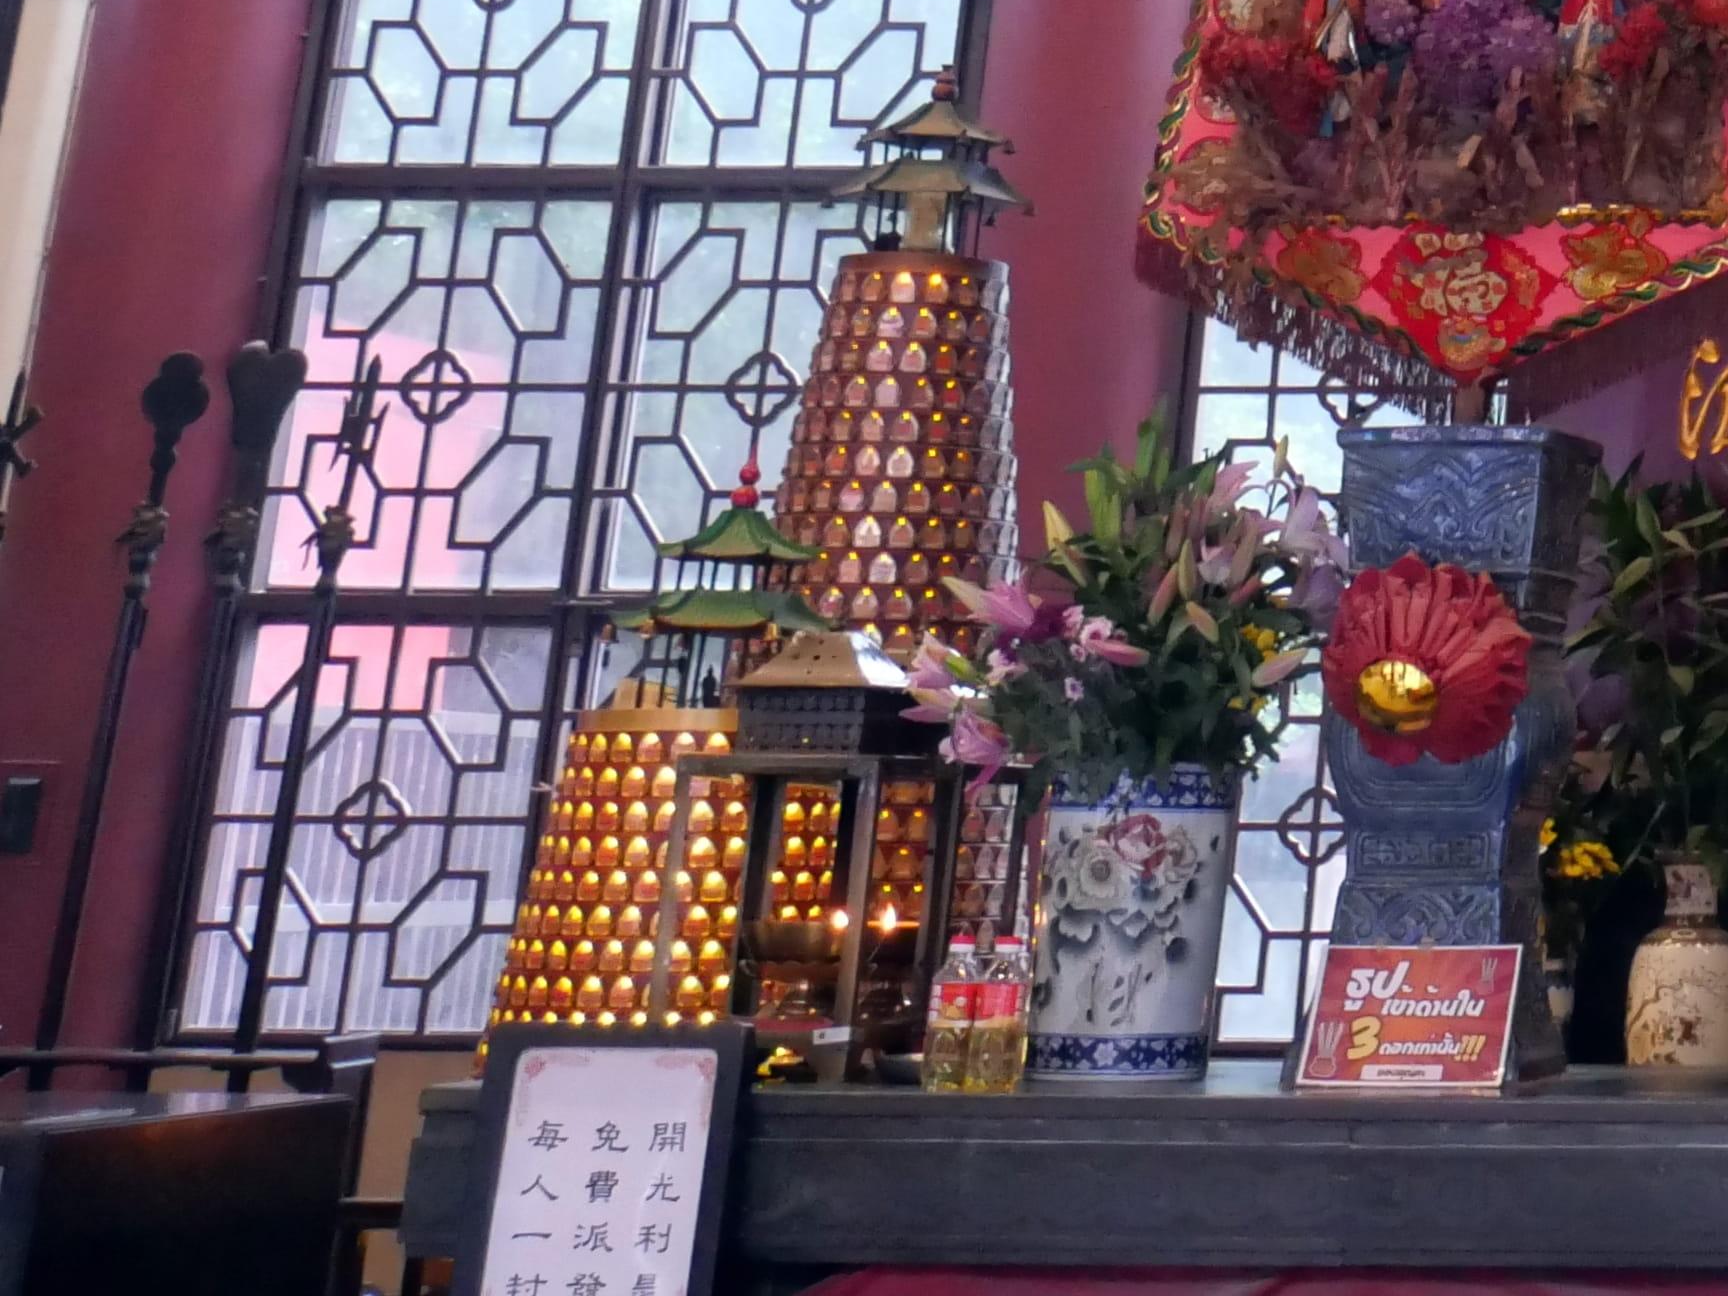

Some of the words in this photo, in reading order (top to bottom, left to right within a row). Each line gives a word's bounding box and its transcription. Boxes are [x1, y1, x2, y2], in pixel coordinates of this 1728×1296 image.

[1409, 231, 1509, 317] 福
[1343, 960, 1410, 1012] ธูป
[1381, 984, 1485, 1018] เข้าด้านใน
[1346, 1015, 1381, 1060] 3
[506, 1120, 569, 1296] 每人一封
[566, 1120, 629, 1296] 免費派發
